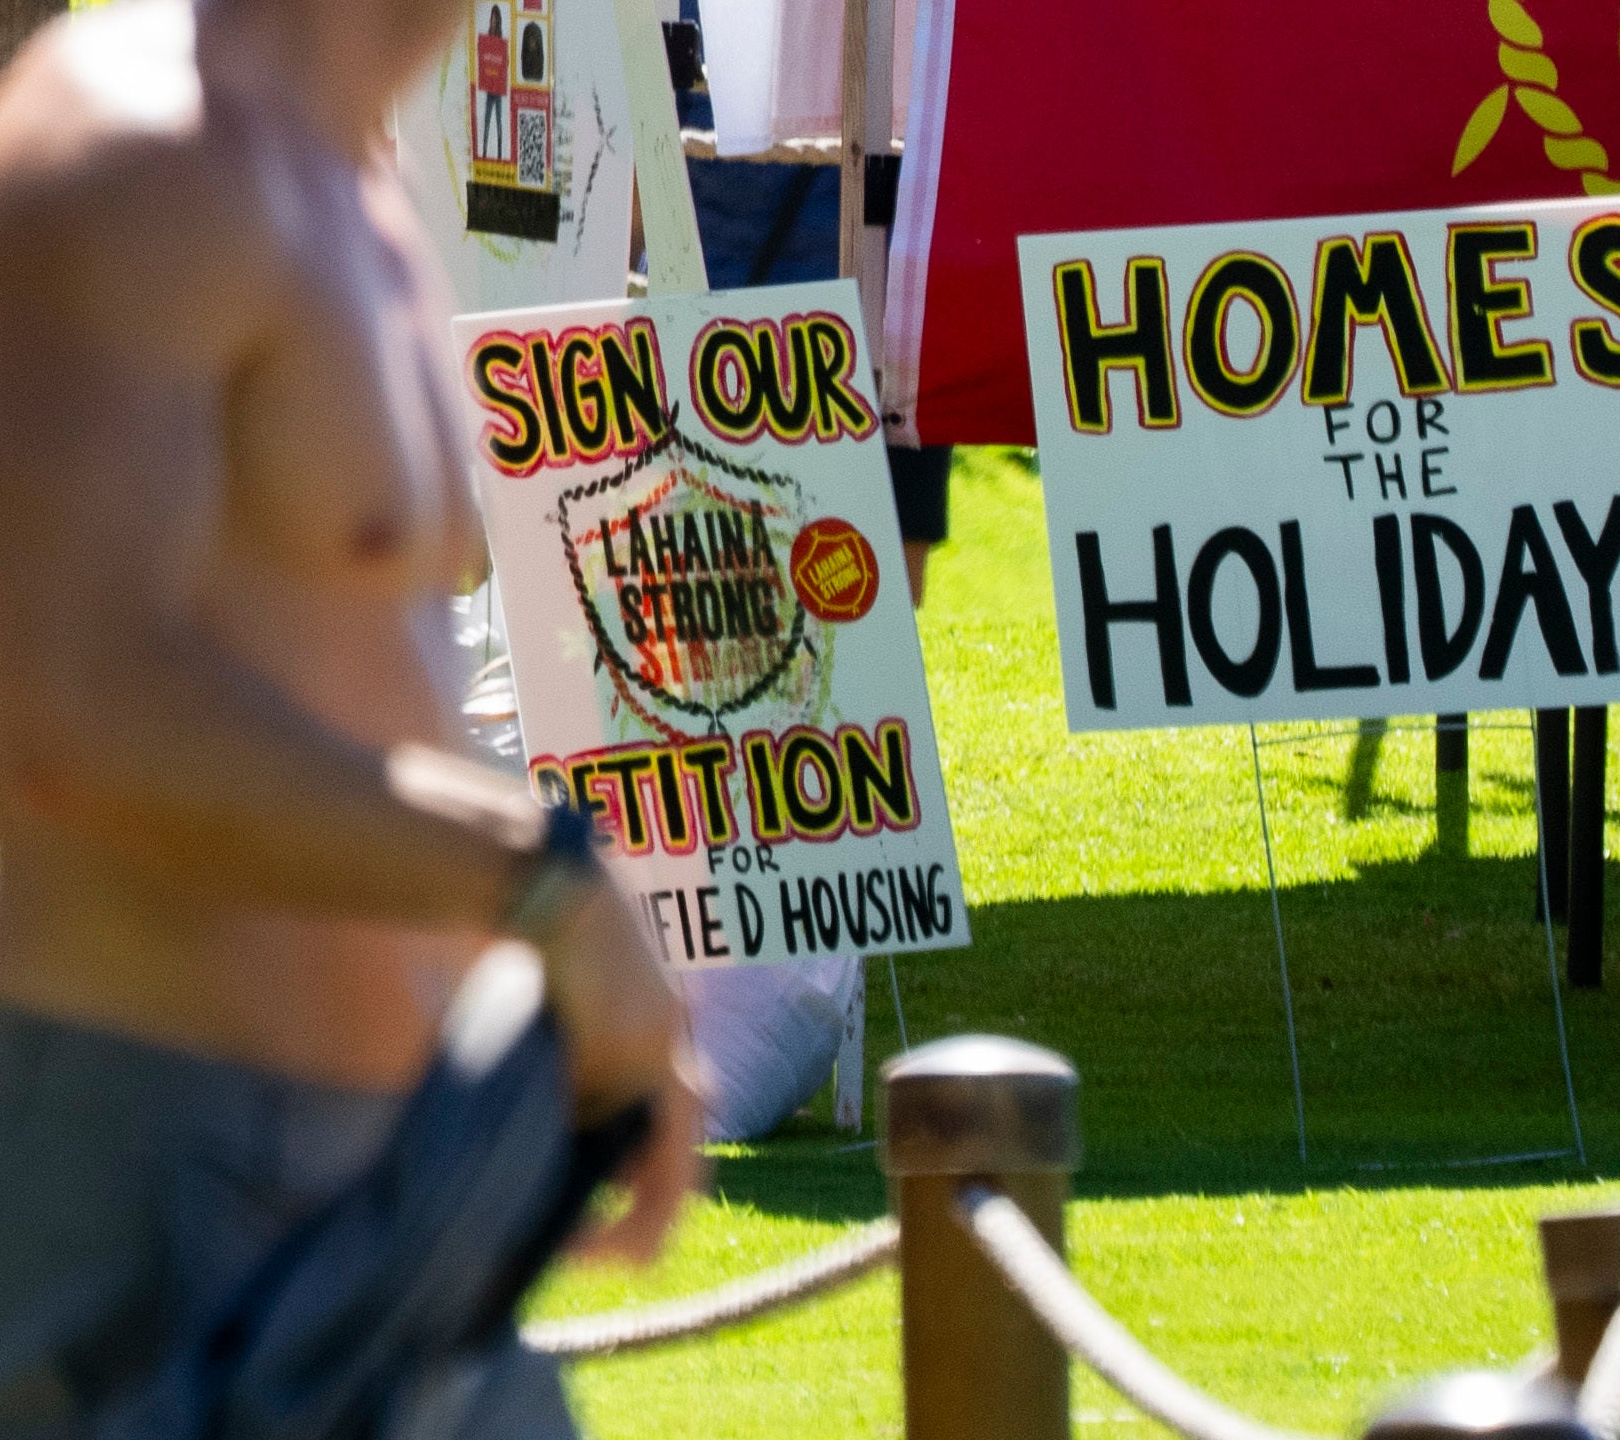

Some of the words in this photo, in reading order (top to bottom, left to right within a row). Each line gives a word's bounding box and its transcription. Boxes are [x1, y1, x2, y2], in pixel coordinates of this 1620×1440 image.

[465, 315, 668, 479] SIGN
[689, 310, 880, 446] OUR
[1324, 399, 1450, 445] FOR
[1323, 446, 1458, 501] THE
[620, 576, 779, 645] STRONG
[707, 844, 781, 875] FOR
[779, 861, 954, 955] HOUSING
